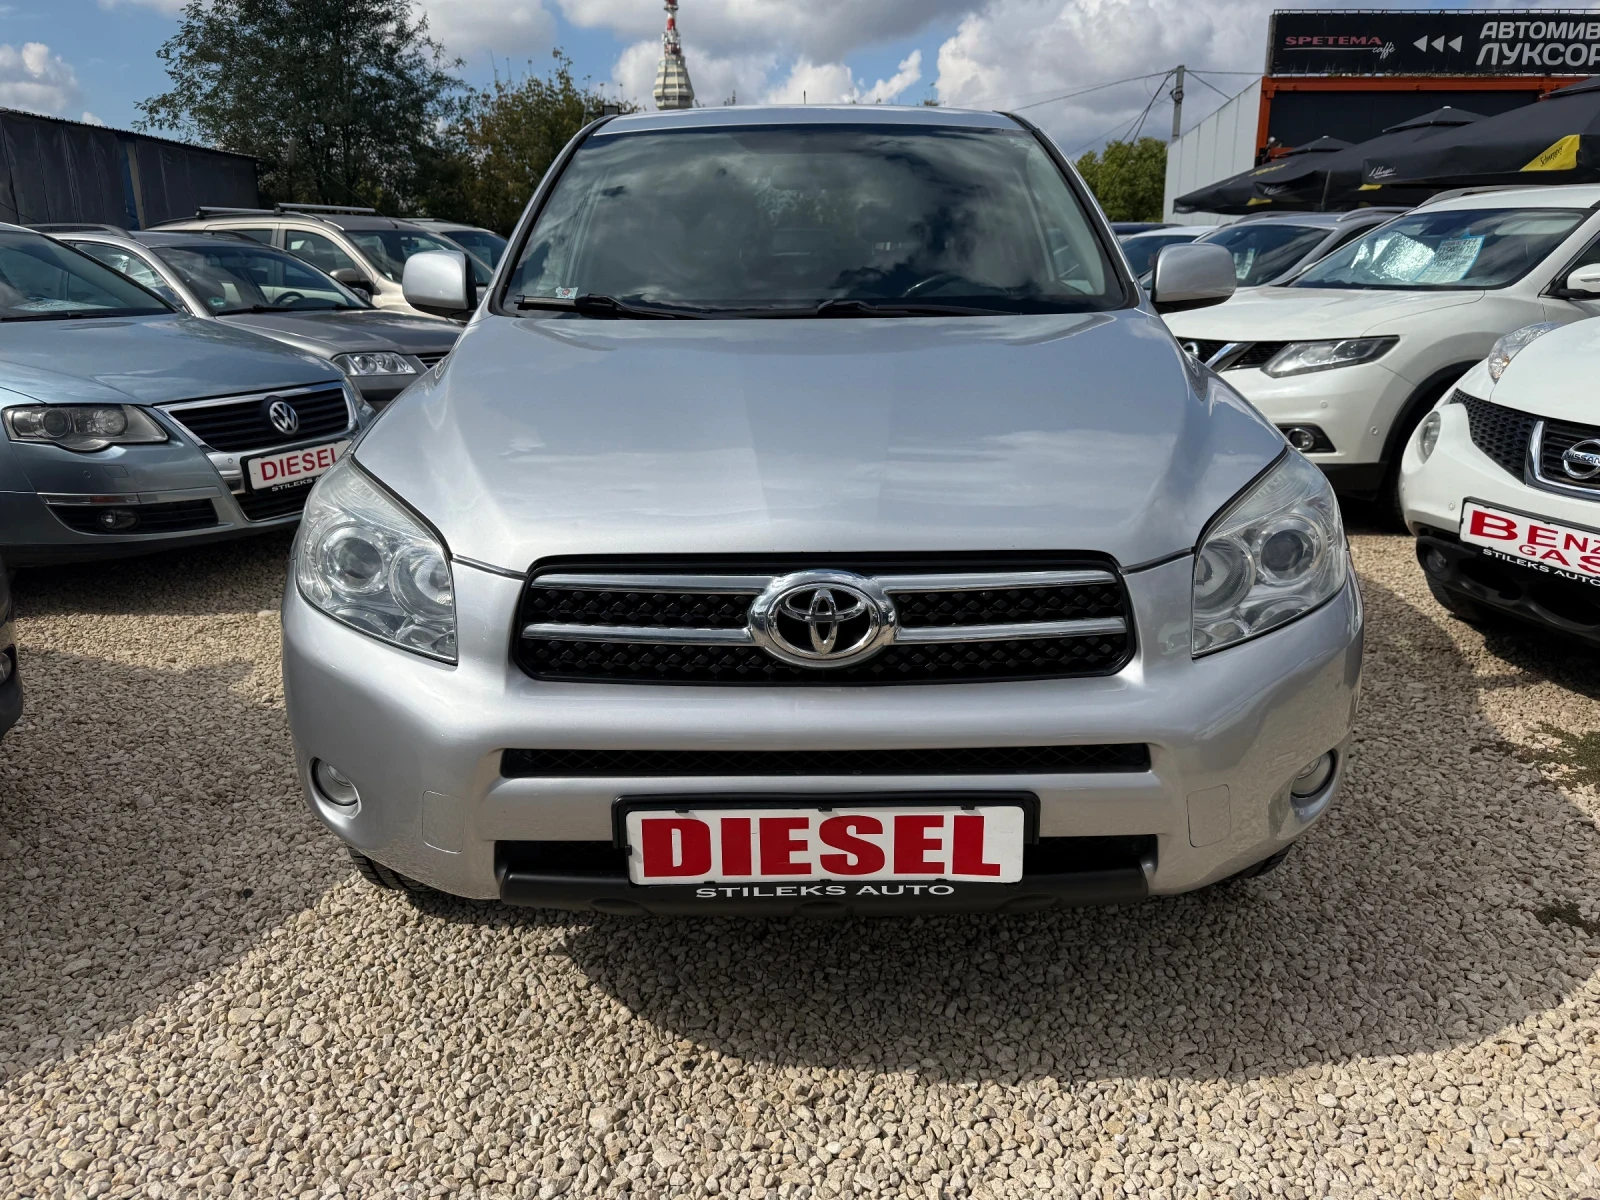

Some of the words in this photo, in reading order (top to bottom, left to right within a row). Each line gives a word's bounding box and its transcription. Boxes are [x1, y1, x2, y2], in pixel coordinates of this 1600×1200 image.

[1285, 36, 1382, 45] SPETEMA
[271, 478, 313, 492] STILEKS
[1482, 548, 1550, 573] STILEKS
[641, 815, 1001, 877] DIESEL
[696, 885, 847, 898] STILEKS
[855, 884, 955, 897] AUTO
